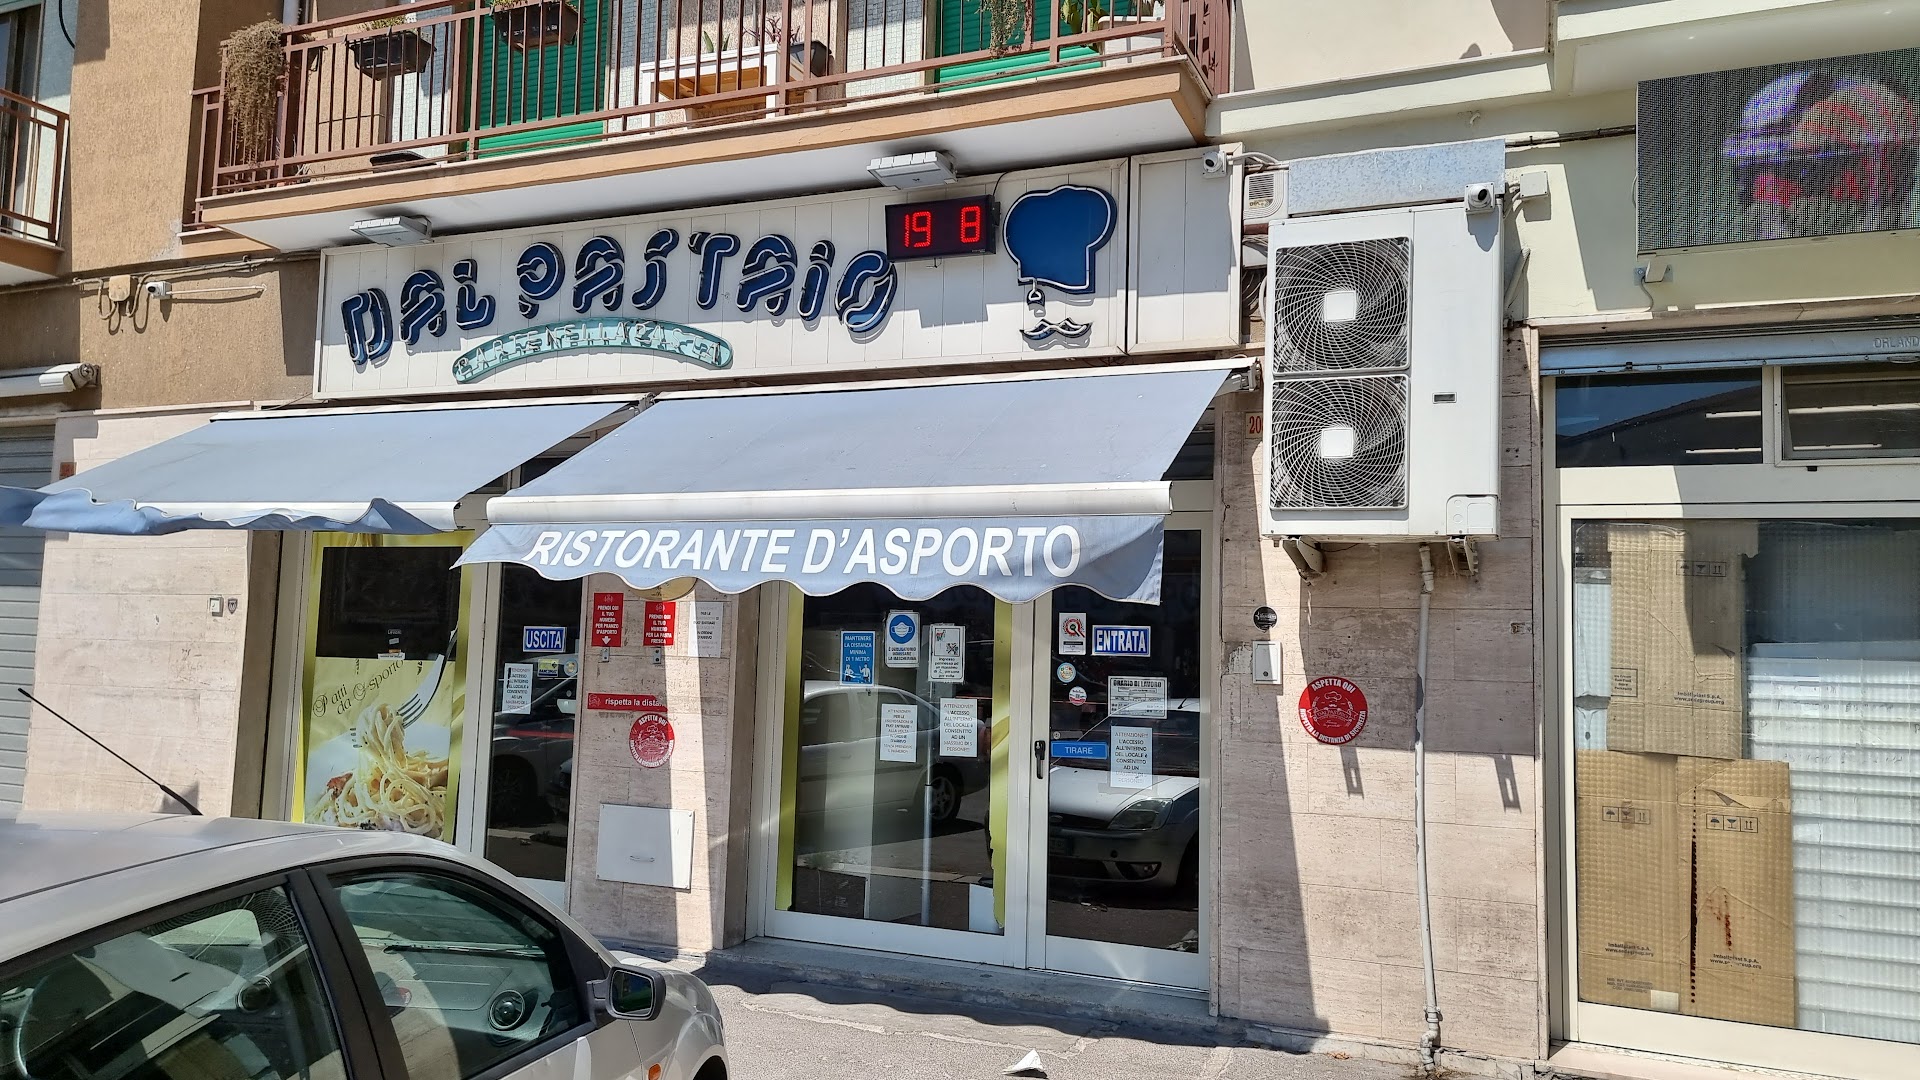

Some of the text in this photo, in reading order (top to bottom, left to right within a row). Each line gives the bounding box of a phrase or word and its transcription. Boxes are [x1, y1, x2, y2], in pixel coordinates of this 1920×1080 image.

[903, 205, 981, 248] 19 8
[340, 227, 898, 366] DAL PASTAIO
[1249, 415, 1264, 434] 20
[521, 525, 1081, 578] RISTORANTE D'ASPORTO
[525, 629, 563, 650] USCITA
[1096, 630, 1146, 652] ENTRATA
[1312, 678, 1356, 693] ASPETTA QUI
[337, 700, 352, 715] da
[605, 697, 632, 706] rispetta
[638, 714, 658, 726] ASPETTA
[1300, 708, 1314, 733] RISPETTA
[1319, 733, 1345, 743] DISTANZA
[1344, 733, 1351, 742] DI
[1350, 711, 1366, 736] SICUREZZA
[1065, 746, 1093, 754] TIRARE
